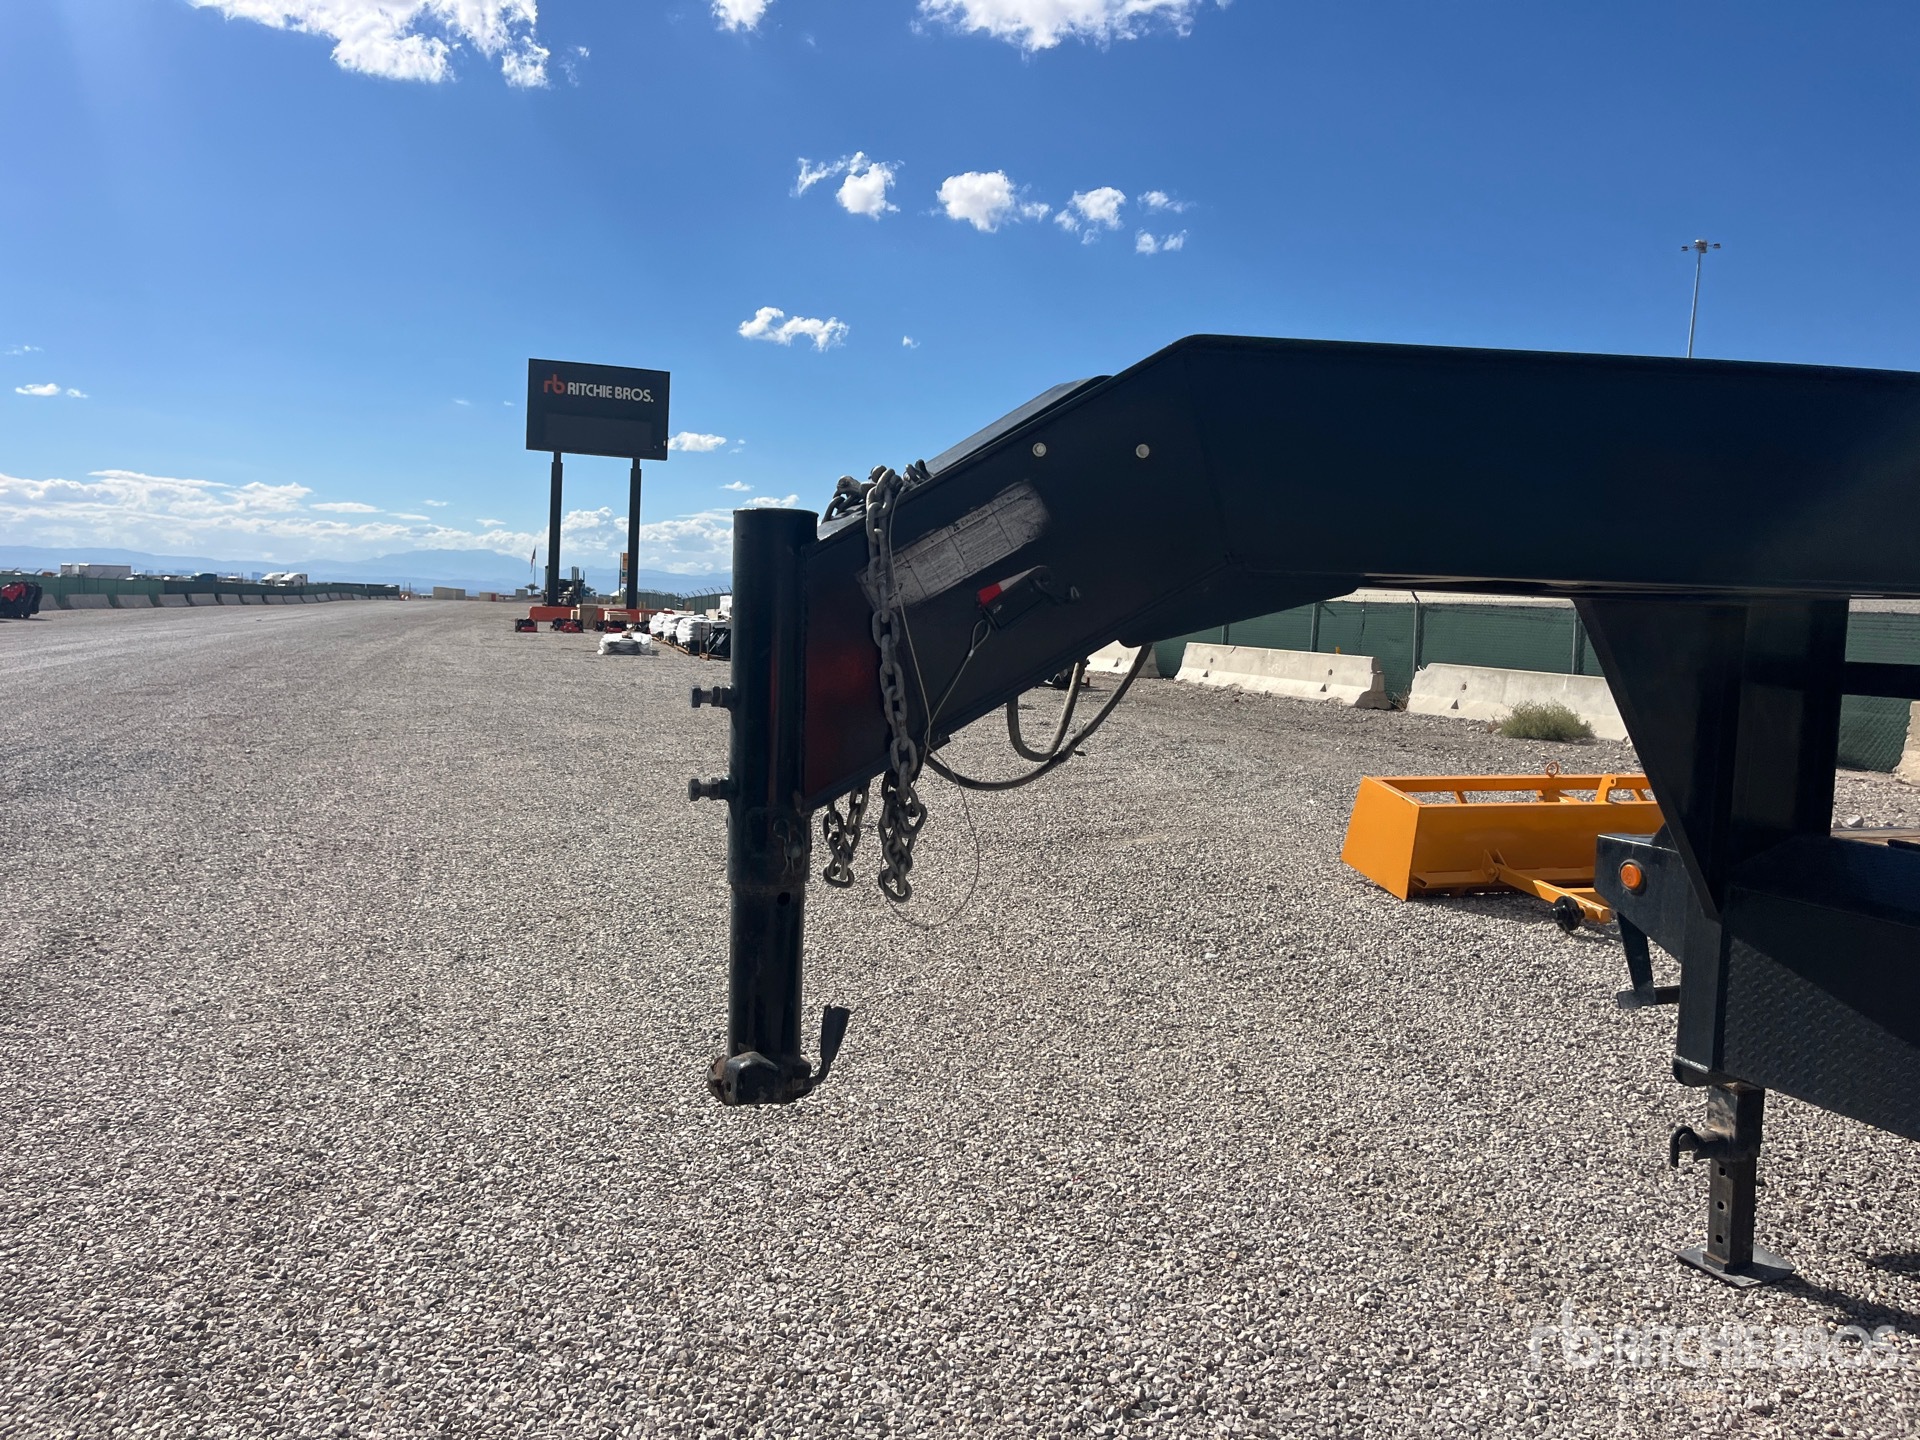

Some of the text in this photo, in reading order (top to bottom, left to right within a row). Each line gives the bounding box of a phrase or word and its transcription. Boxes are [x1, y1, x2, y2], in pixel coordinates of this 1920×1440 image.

[543, 373, 654, 403] rb RITCHIE BROS.
[960, 508, 989, 528] CAUTION
